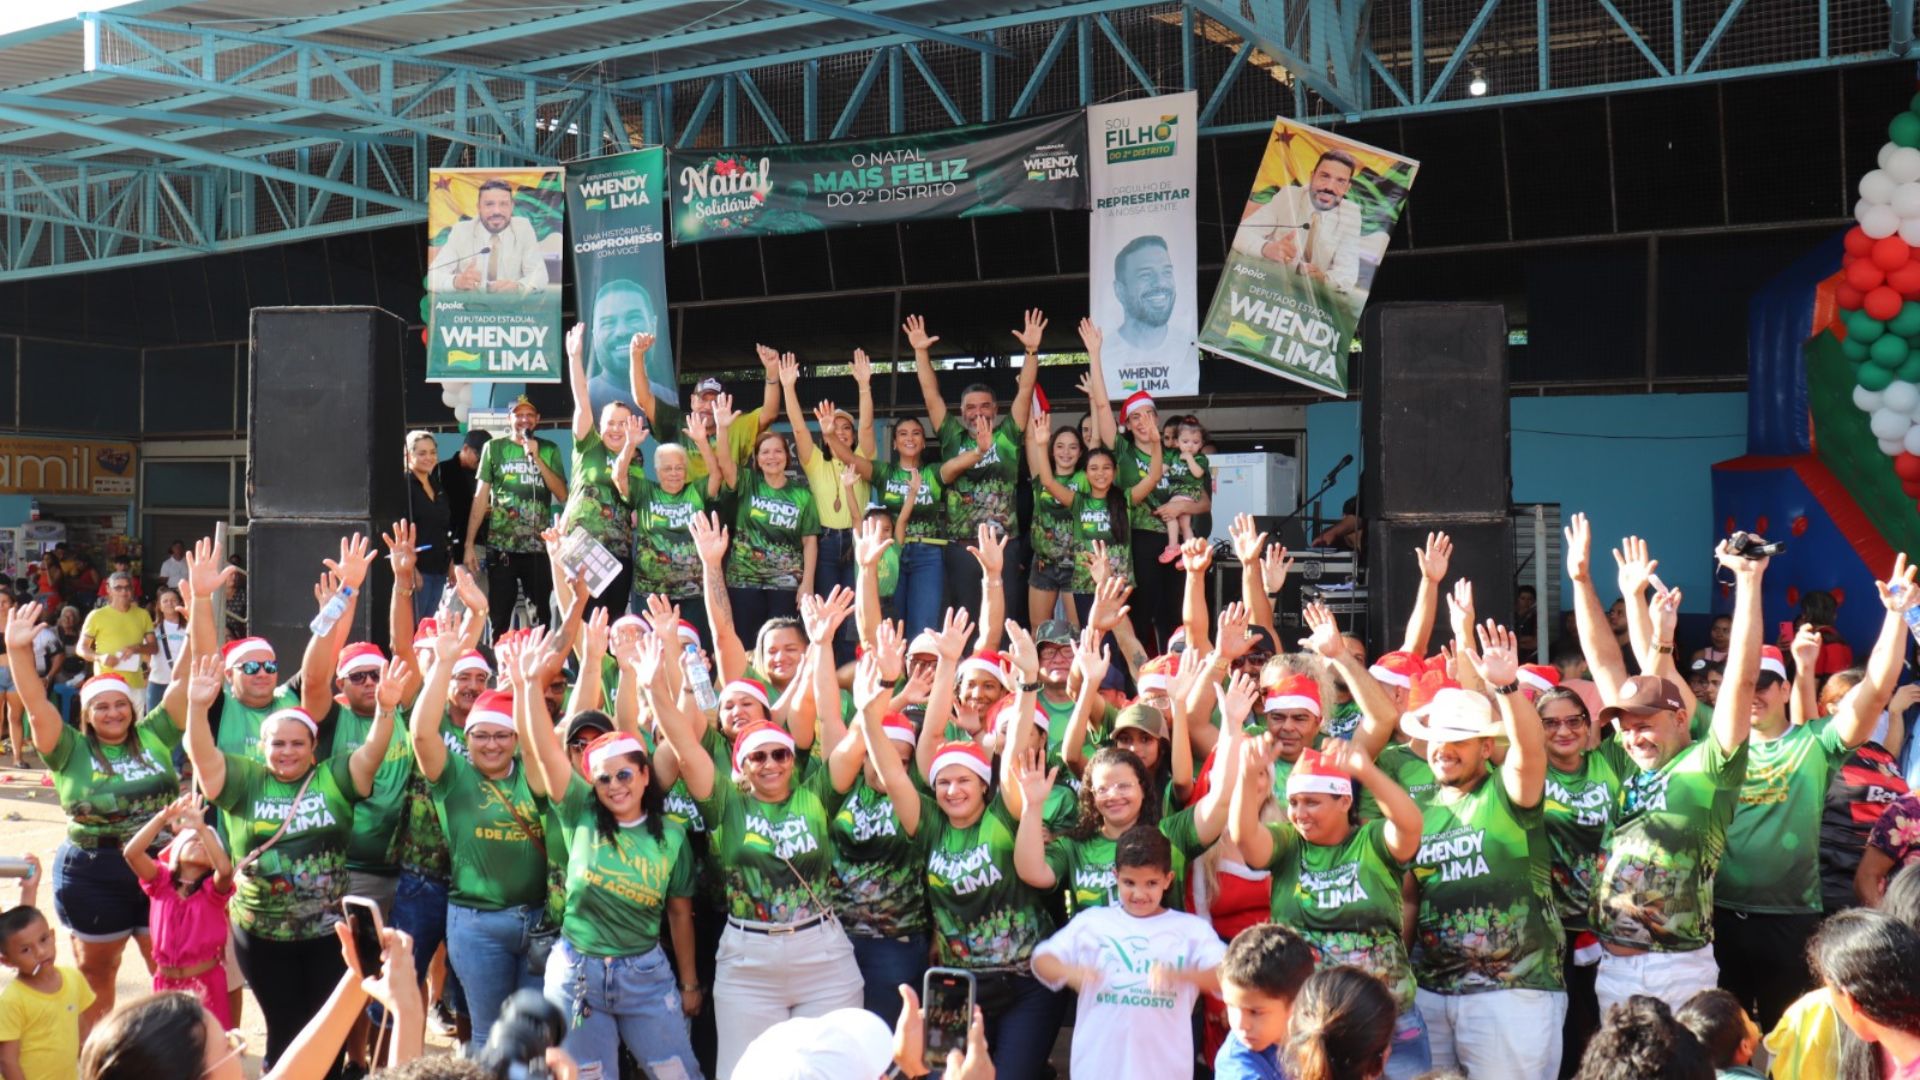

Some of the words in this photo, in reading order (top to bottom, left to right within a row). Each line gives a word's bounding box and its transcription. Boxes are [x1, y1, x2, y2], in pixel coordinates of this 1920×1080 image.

[1105, 117, 1130, 129] SOU
[1105, 123, 1171, 148] FILHO
[851, 154, 865, 168] O
[870, 148, 926, 166] NATAL
[1023, 154, 1078, 171] WHENDY
[680, 157, 774, 204] Natal
[813, 165, 885, 193] MAIS
[890, 158, 969, 186] FELIZ
[1048, 167, 1080, 180] LIMA
[579, 174, 649, 198] WHENDY
[827, 192, 854, 207] DO
[878, 182, 956, 202] DISTRITO
[610, 191, 650, 209] LIMA
[695, 196, 758, 219] Solidário
[1097, 188, 1190, 209] REPRESENTAR
[574, 232, 663, 253] COMPROMISSO
[582, 232, 601, 242] UMA
[640, 224, 653, 233] DE
[1248, 284, 1297, 308] DEPUTADO
[453, 315, 496, 324] DEPUTADO
[1230, 291, 1340, 352] WHENDY
[440, 326, 549, 348] WHENDY
[488, 350, 548, 371] LIMA
[1270, 335, 1338, 380] LIMA
[1118, 366, 1169, 380] WHENDY
[1141, 379, 1170, 391] LIMA
[751, 496, 800, 518] WHENDY
[1080, 512, 1110, 522] WHEN
[769, 513, 798, 529] LIMA
[484, 828, 503, 840] DE
[929, 844, 992, 879] WHENDY
[1441, 854, 1490, 882] LIMA
[953, 864, 1003, 895] LIMA
[1318, 880, 1368, 909] LIMA
[1120, 994, 1175, 1009] AGOSTO
